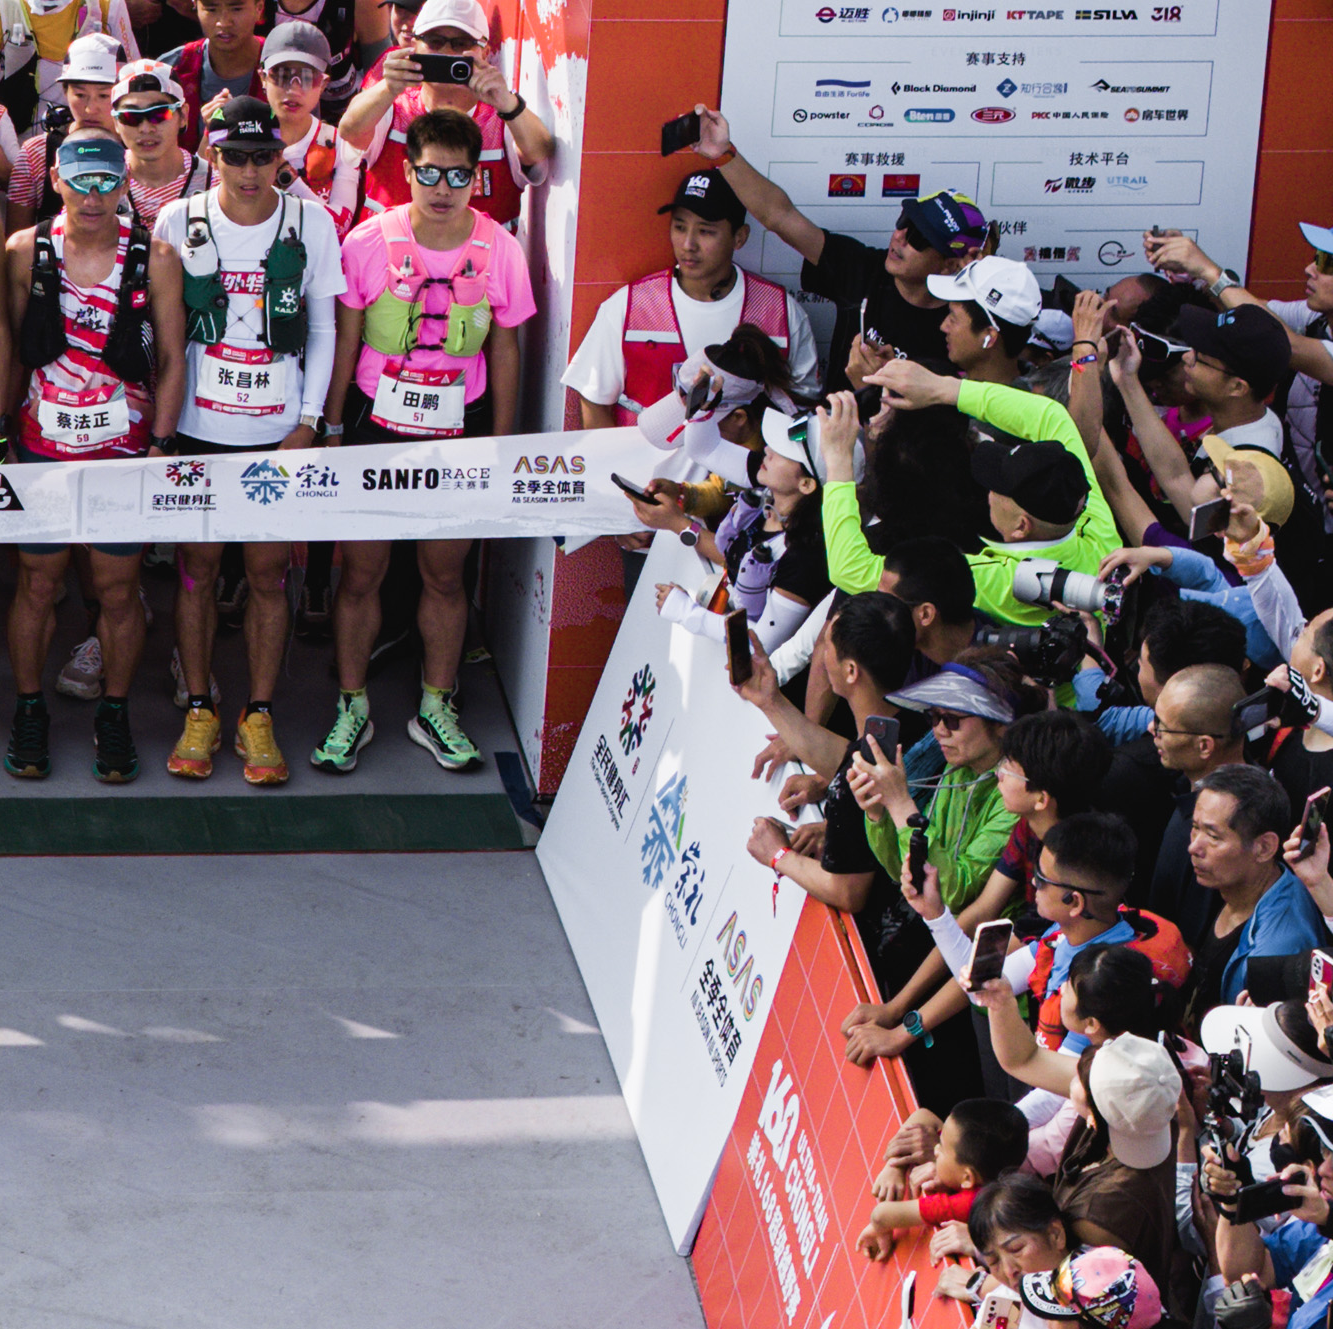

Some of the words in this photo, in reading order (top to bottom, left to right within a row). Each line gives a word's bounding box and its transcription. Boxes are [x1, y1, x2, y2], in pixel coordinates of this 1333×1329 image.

[839, 8, 870, 20] 迈胜
[957, 10, 995, 21] injinji
[1093, 10, 1138, 20] SILVA
[967, 52, 1025, 65] 赛事支持
[810, 111, 850, 120] powster
[1142, 109, 1188, 121] 房车世界
[845, 152, 905, 166] 赛事救援
[1070, 152, 1129, 166] 技术平台
[1107, 176, 1148, 184] UTRAIL
[218, 367, 270, 389] 张昌林
[236, 391, 250, 403] 52
[403, 391, 439, 411] 田鹏
[56, 411, 109, 430] 蔡法正
[413, 412, 425, 423] 51
[363, 468, 439, 490] SANFO
[441, 468, 490, 480] RACE
[442, 481, 489, 489] 三夫赛事
[513, 480, 585, 494] 全季全体育
[153, 494, 216, 506] 全民健身汇
[665, 892, 688, 950] CHONGLI
[699, 959, 742, 1067] 全季全体育
[798, 1129, 829, 1242] ULTRA-TRAIL
[787, 1168, 821, 1280] CHONGLI
